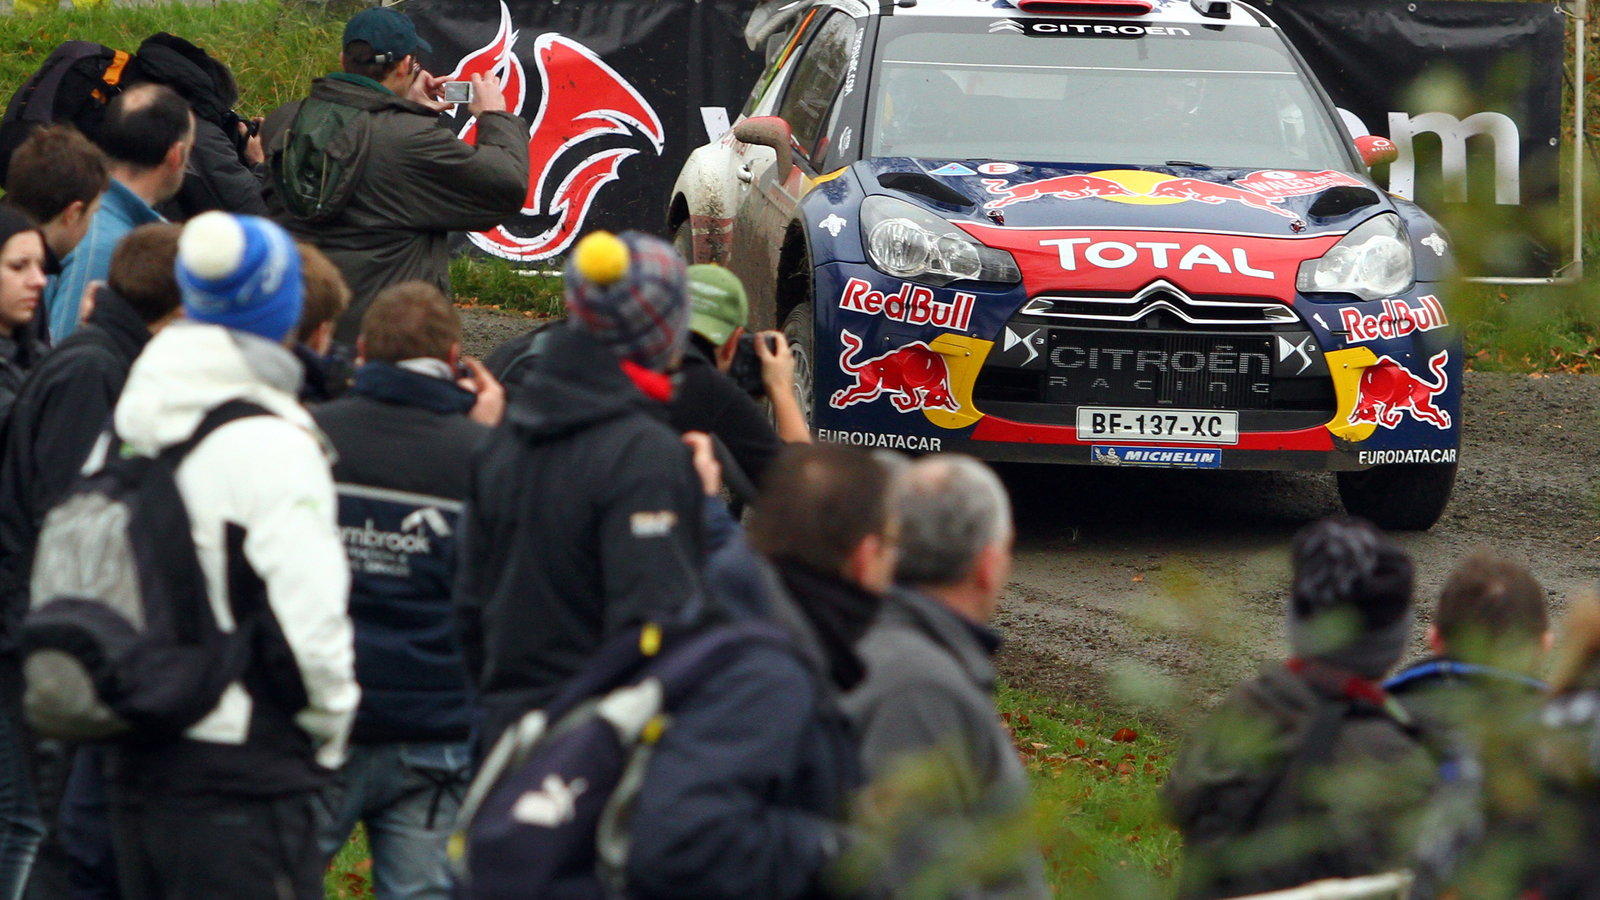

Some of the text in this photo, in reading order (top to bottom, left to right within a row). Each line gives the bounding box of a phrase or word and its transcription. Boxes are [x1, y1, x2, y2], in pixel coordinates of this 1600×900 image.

[988, 164, 1008, 173] E
[1243, 178, 1315, 192] WALES
[1039, 237, 1276, 280] TOTAL
[1050, 376, 1270, 394] RACING
[1092, 413, 1222, 438] BF-137-XC
[818, 428, 942, 452] EURODATACAR
[1124, 450, 1216, 463] MICHELIN
[1359, 448, 1457, 465] EURODATACAR
